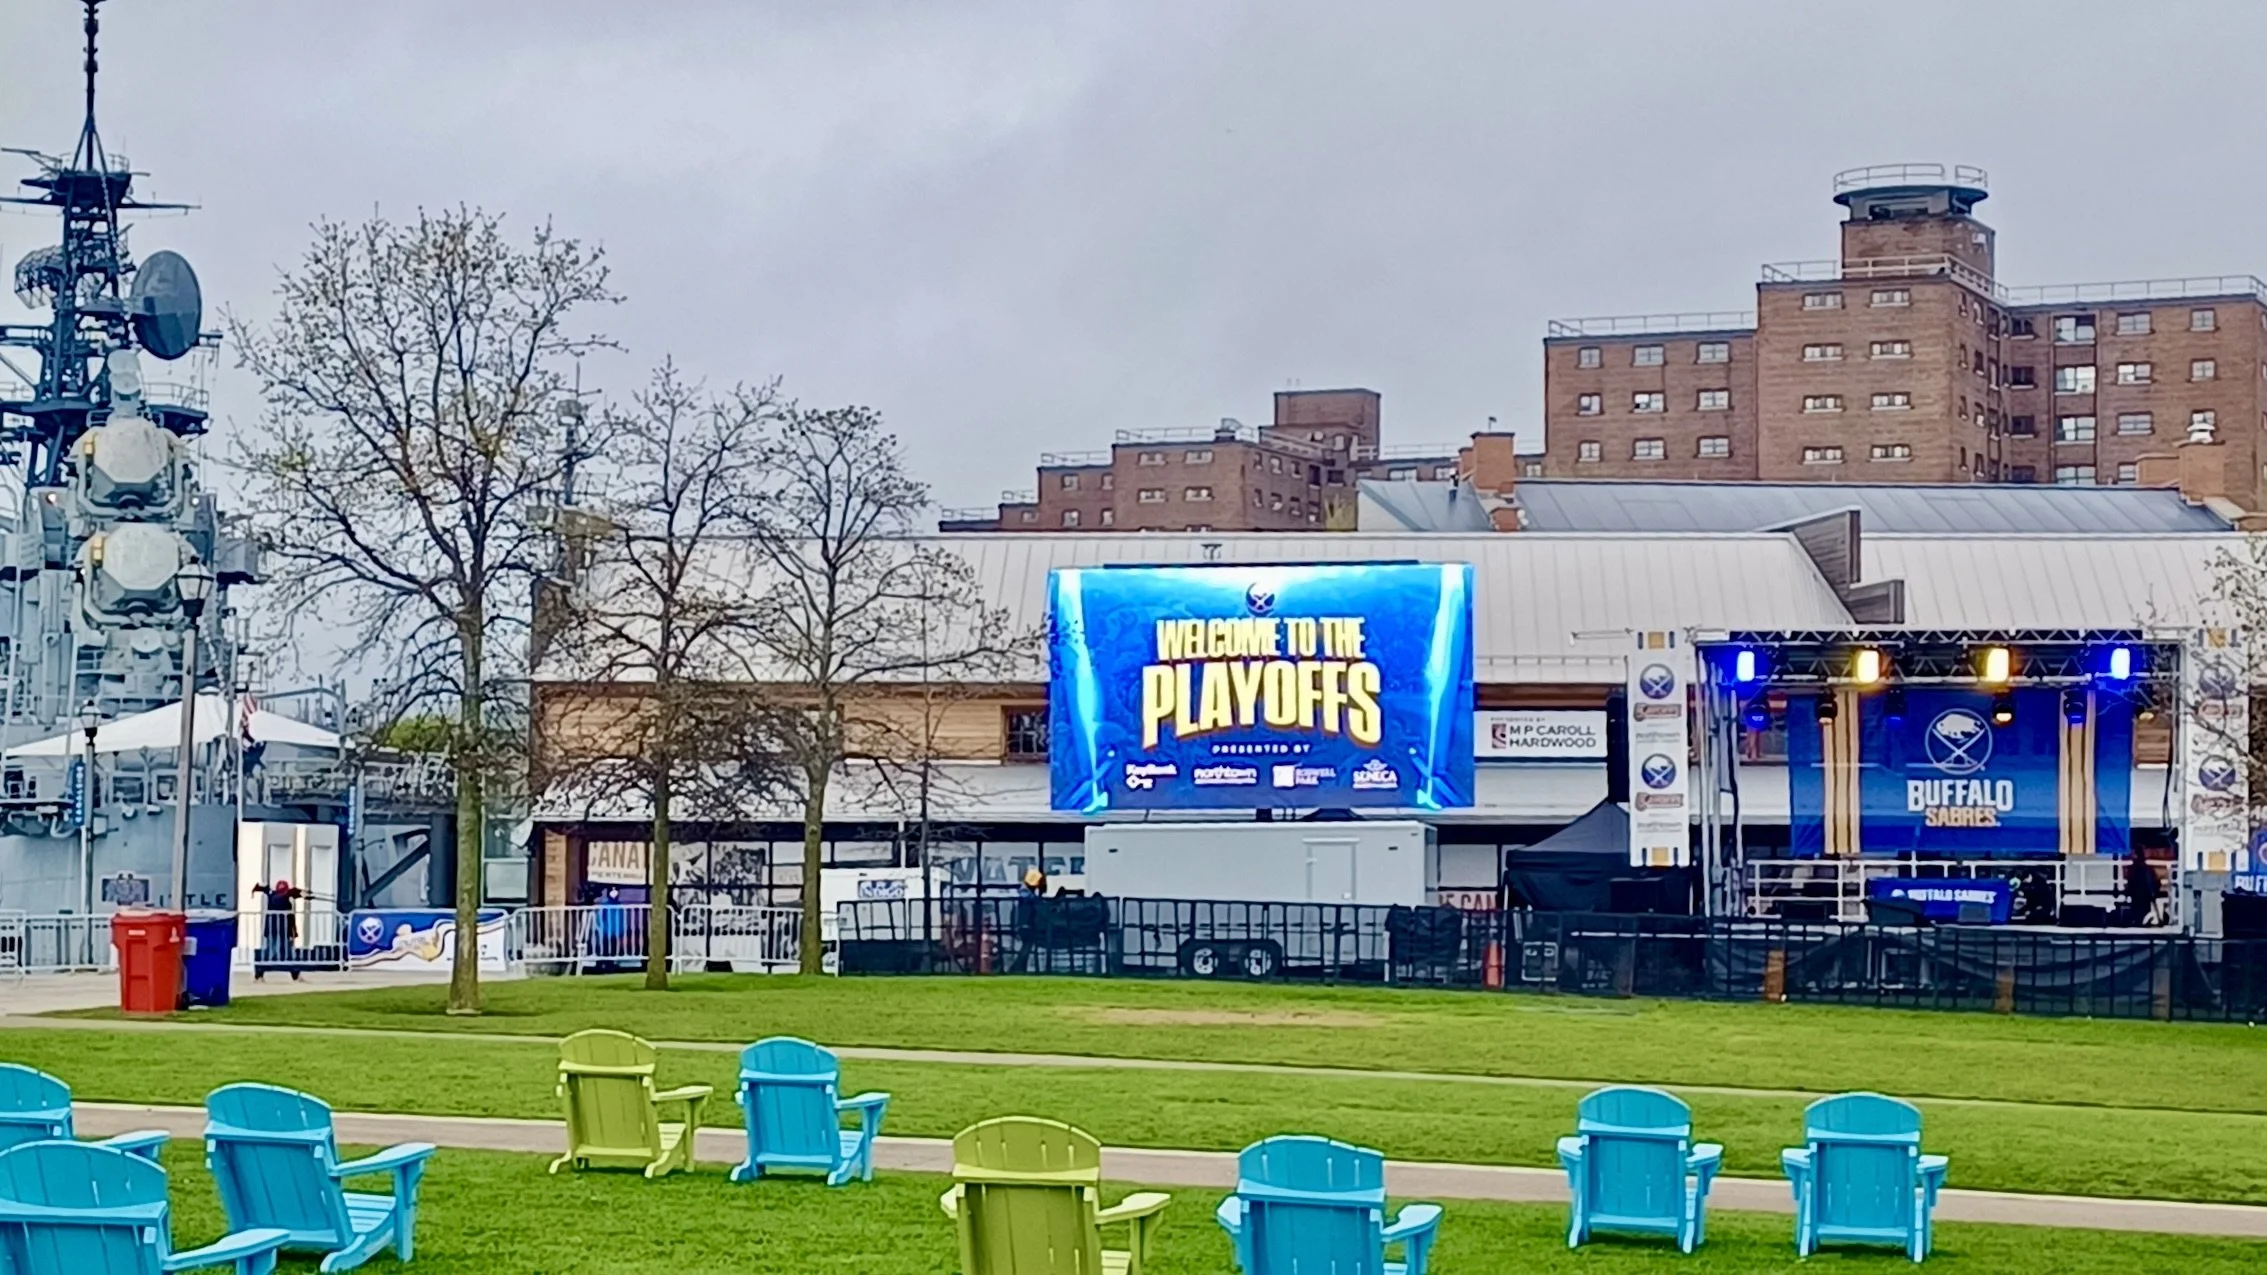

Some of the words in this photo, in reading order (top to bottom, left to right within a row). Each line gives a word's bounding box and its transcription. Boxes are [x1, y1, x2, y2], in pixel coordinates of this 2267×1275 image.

[1156, 617, 1281, 661] WELCOME
[1283, 617, 1316, 657] TO
[1319, 617, 1366, 659] THE
[1142, 659, 1381, 750] PLAYOFFS
[1510, 725, 1520, 735] M
[1524, 725, 1533, 735] P
[1536, 725, 1596, 736] CAROLL
[1212, 744, 1289, 754] PRESENTED
[1293, 744, 1310, 754] BY
[1509, 737, 1597, 748] HARDWOOD
[1353, 770, 1397, 783] SENECA
[1907, 779, 2013, 811] BUFFALO
[1925, 806, 1997, 827] SABRES
